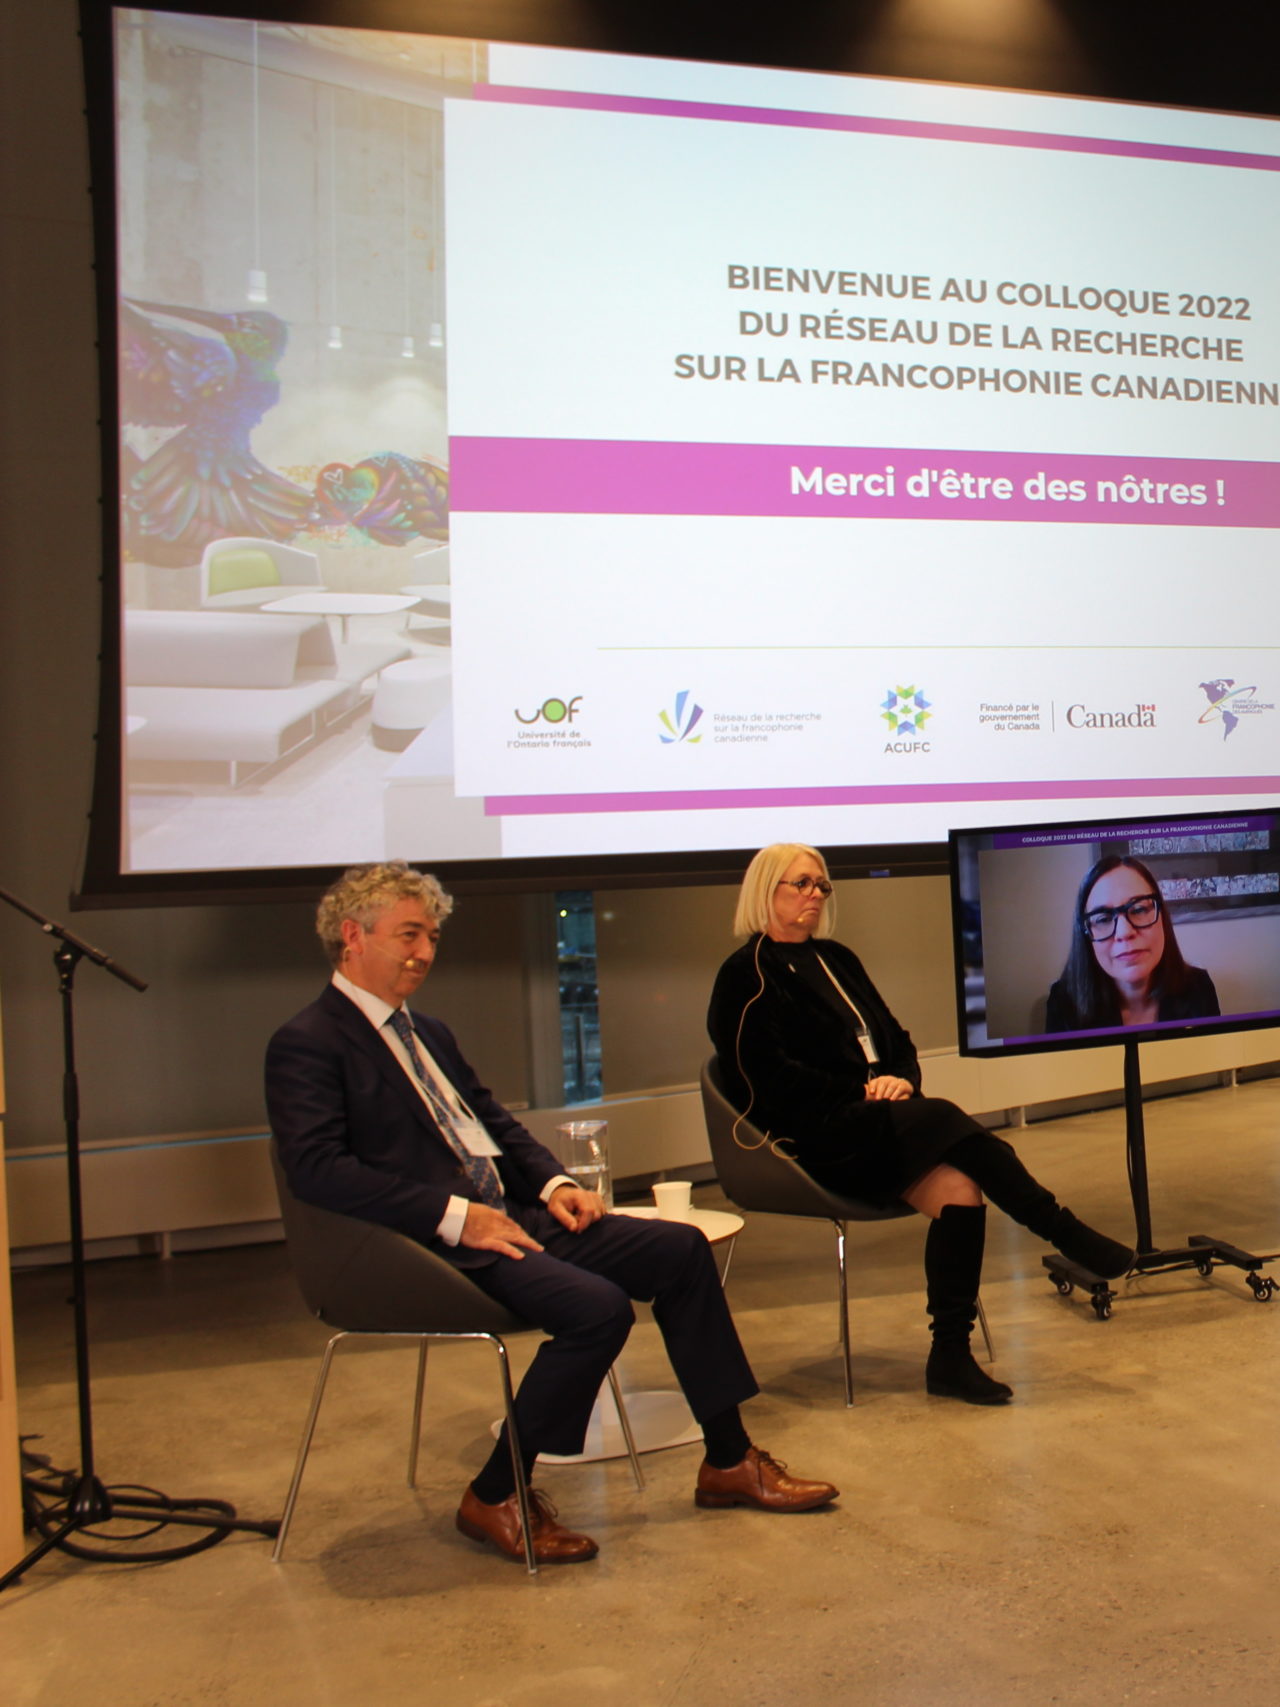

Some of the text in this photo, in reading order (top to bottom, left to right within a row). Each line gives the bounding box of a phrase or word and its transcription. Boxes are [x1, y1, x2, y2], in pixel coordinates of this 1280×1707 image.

[727, 264, 1252, 321] BIENVENUE AU COLLOQUE 2022
[738, 308, 1244, 362] DU RÉSEAU DE LA RECHERCHE
[674, 353, 747, 381] SUR
[757, 357, 802, 384] LA
[810, 359, 1083, 396] FRANCOPHONIE
[790, 465, 1226, 506] Merci d'être des nôtres !
[980, 703, 1040, 713] Financé par le
[713, 712, 823, 722] Réseau de la recherche
[979, 713, 1040, 723] gouvernement
[1066, 703, 1156, 728] Canada
[730, 724, 739, 732] la
[741, 723, 804, 733] francophonie
[1007, 723, 1040, 731] Canada
[517, 731, 567, 739] Université
[713, 735, 769, 743] canadienne
[506, 740, 592, 749] l'Ontario français
[884, 742, 931, 753] ACUFC
[1022, 835, 1052, 843] COLLOQUE
[1067, 832, 1077, 840] DU
[1077, 830, 1099, 839] RÉSEAU
[1099, 830, 1108, 838] DE
[1108, 829, 1117, 837] LA
[1116, 828, 1149, 836] RECHERCHE
[1170, 823, 1213, 832] FRANCOPHONIE
[1213, 821, 1249, 830] CANADIENNE
